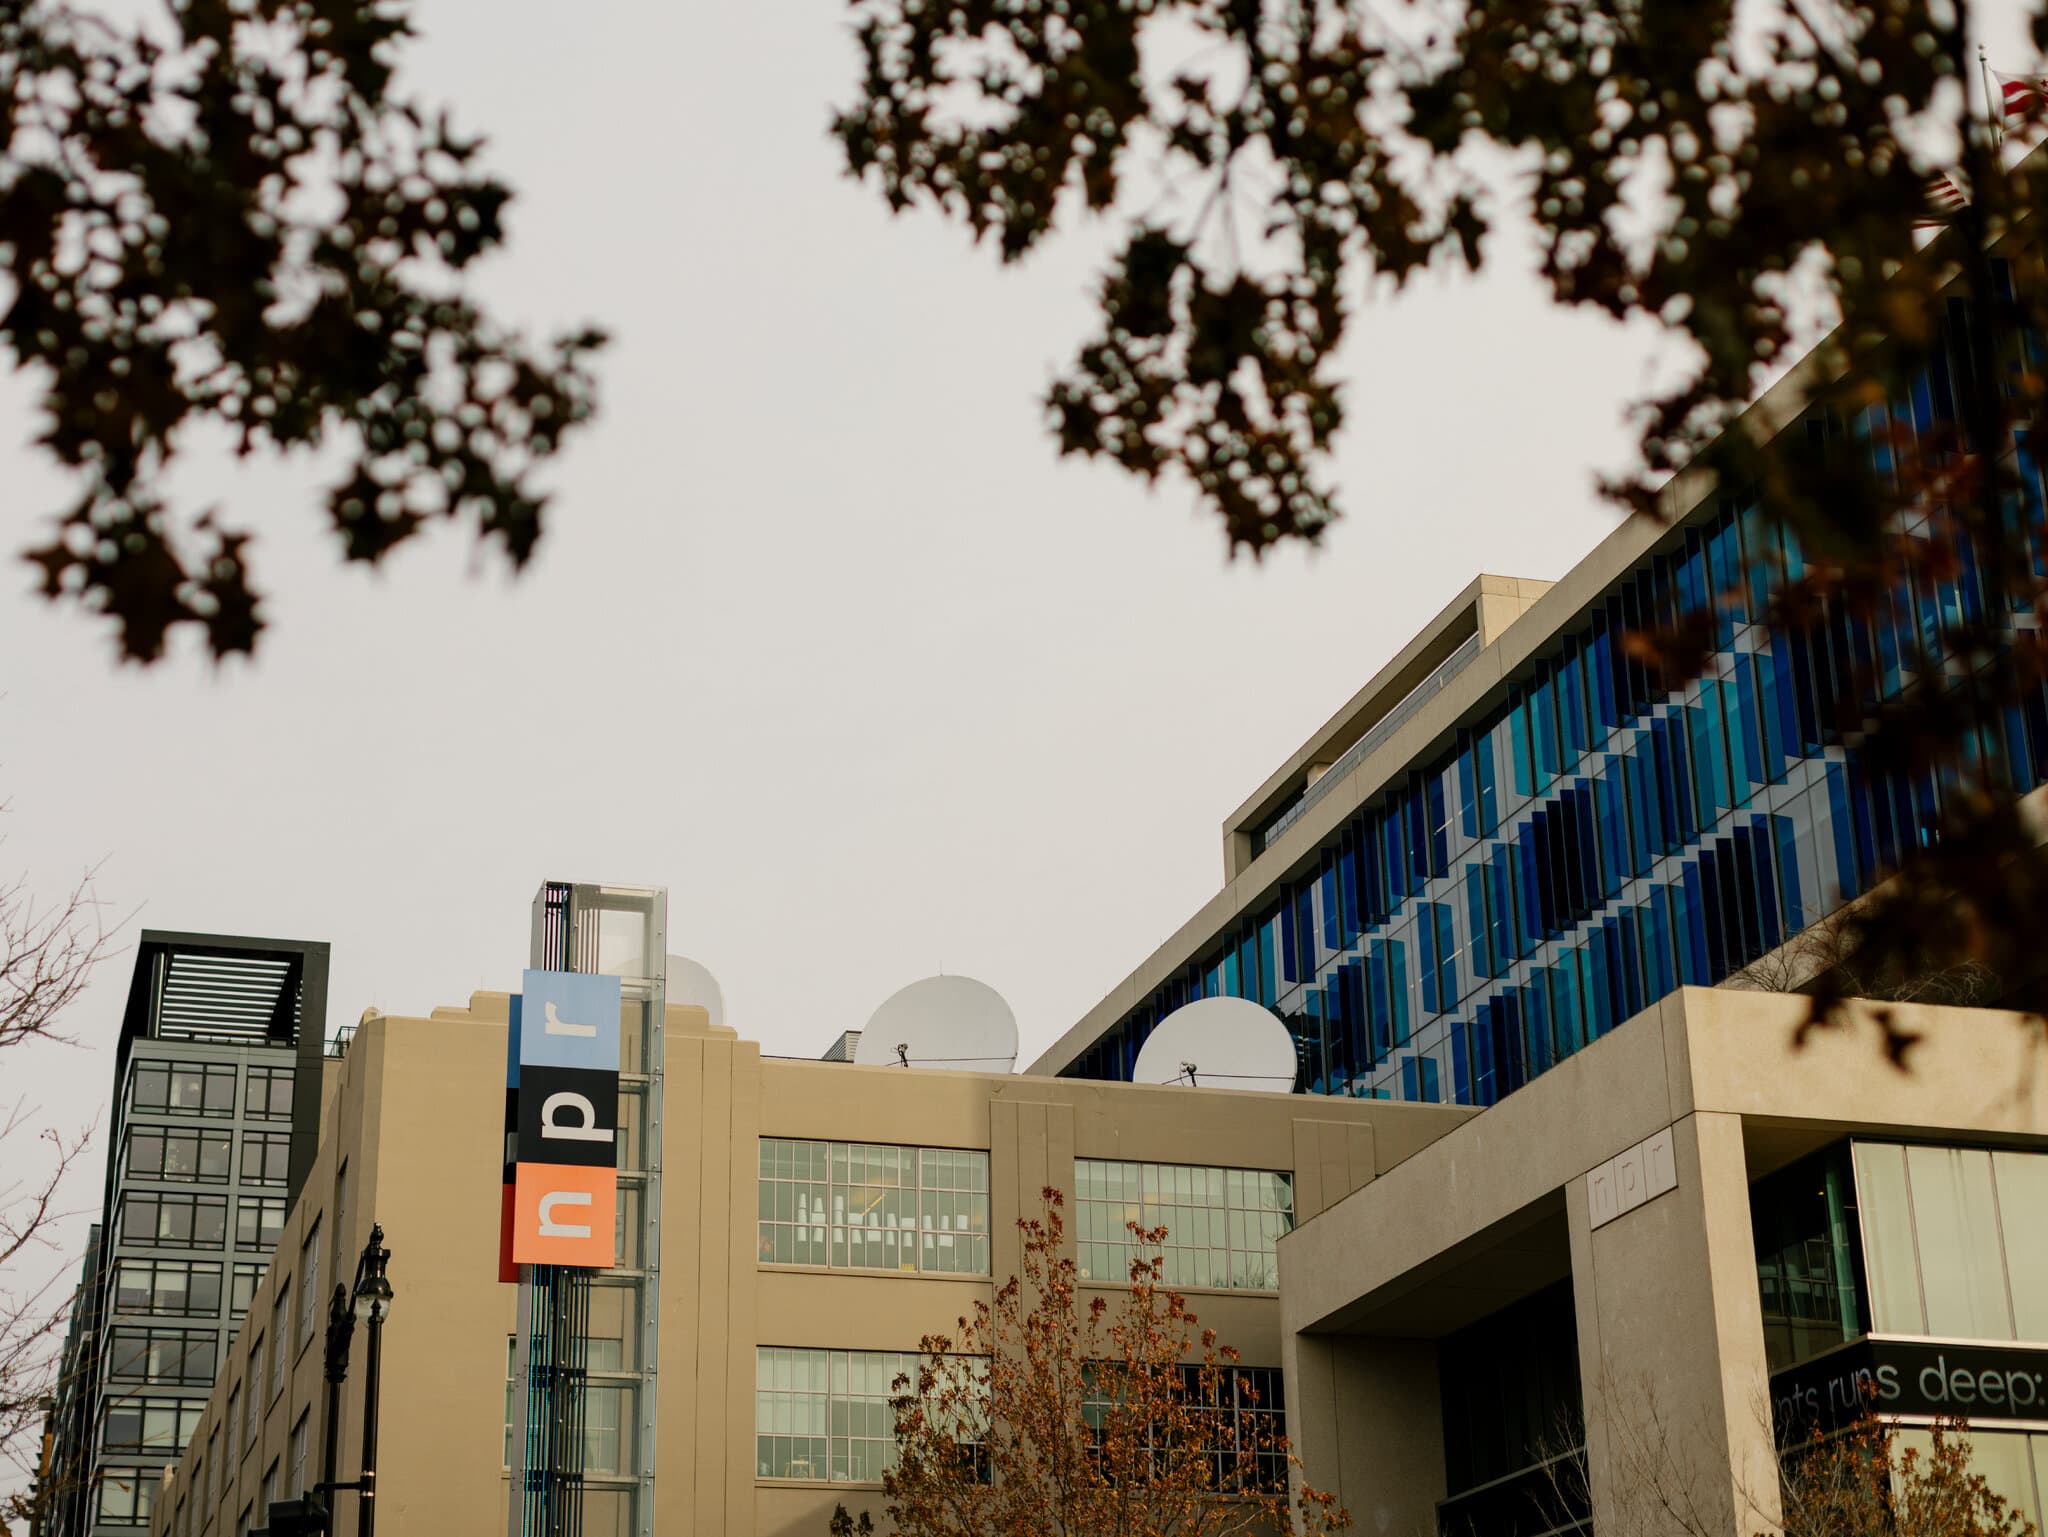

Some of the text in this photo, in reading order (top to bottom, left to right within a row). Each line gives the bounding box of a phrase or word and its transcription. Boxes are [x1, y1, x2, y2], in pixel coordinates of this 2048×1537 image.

[538, 1001, 614, 1238] npr
[1594, 1144, 1663, 1215] npr
[1777, 1382, 1821, 1423] nts
[1829, 1364, 1901, 1412] runs
